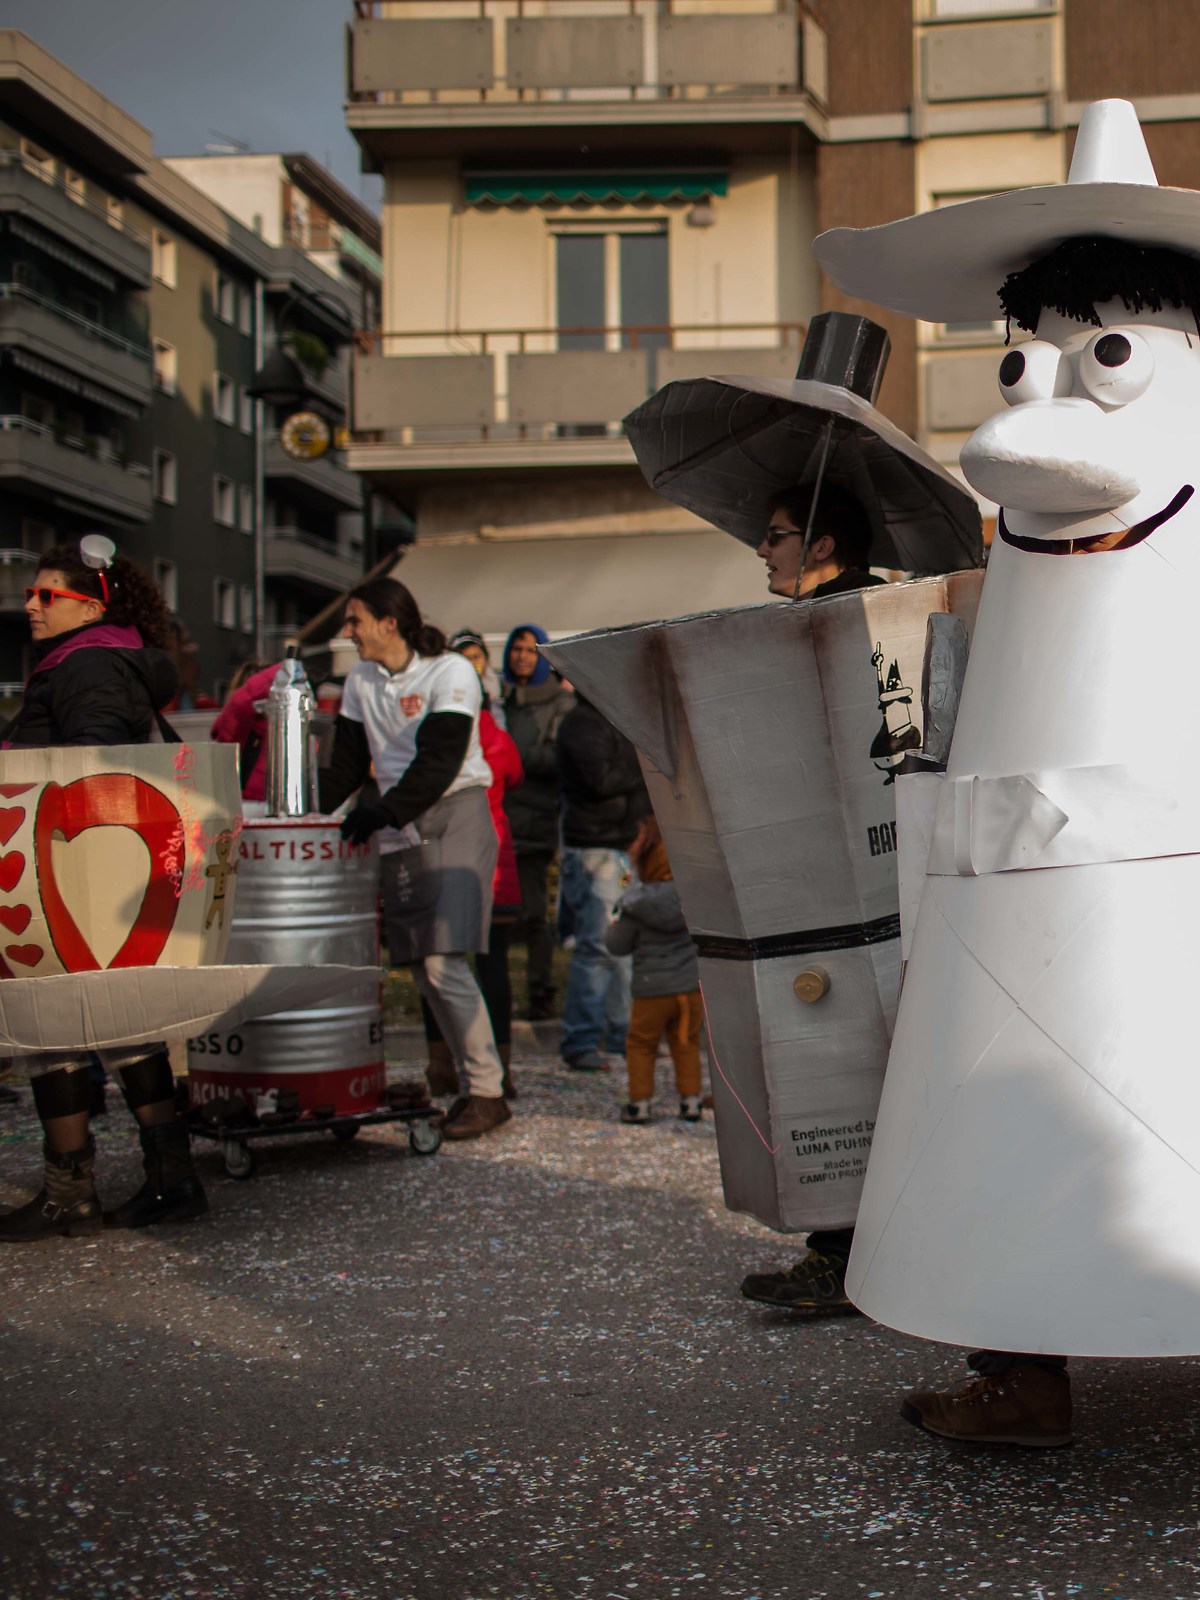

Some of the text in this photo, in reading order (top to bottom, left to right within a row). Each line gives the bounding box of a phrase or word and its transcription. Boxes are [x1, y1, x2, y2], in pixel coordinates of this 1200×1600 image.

[791, 1121, 863, 1142] Engineered
[796, 1142, 831, 1156] LUNA
[824, 1158, 862, 1170] Made in
